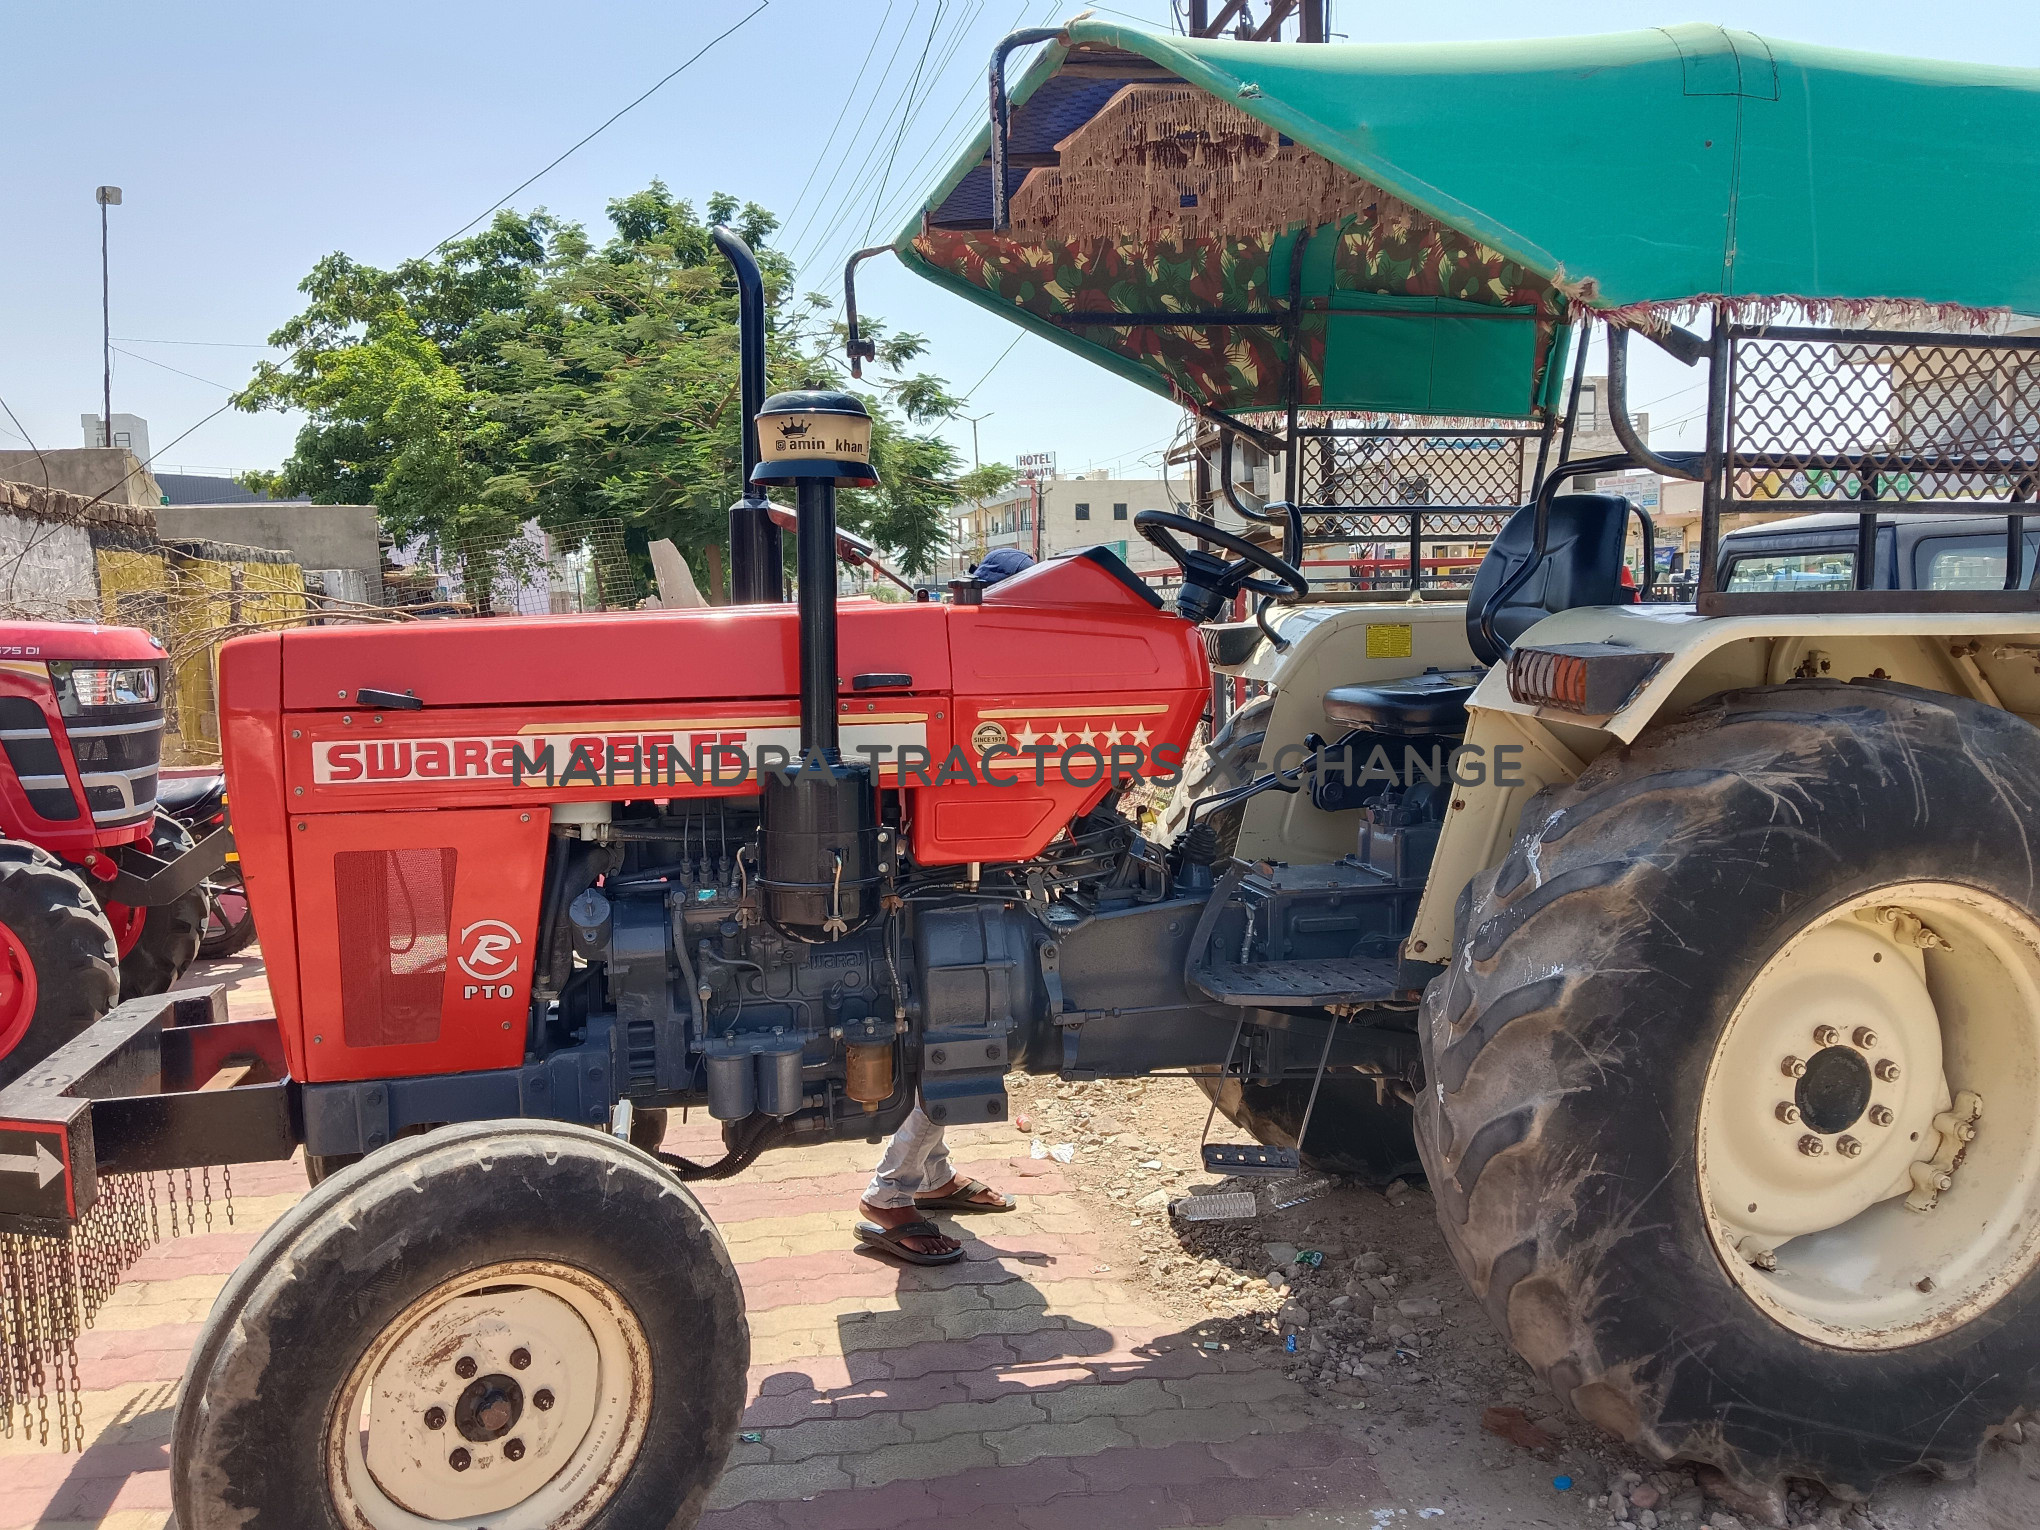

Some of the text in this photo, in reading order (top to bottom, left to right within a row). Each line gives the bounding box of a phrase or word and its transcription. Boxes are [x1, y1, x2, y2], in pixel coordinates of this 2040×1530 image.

[1019, 453, 1052, 466] HOTEL
[0, 646, 40, 655] 75 DI
[570, 734, 675, 772] 855
[464, 984, 514, 999] PTO
